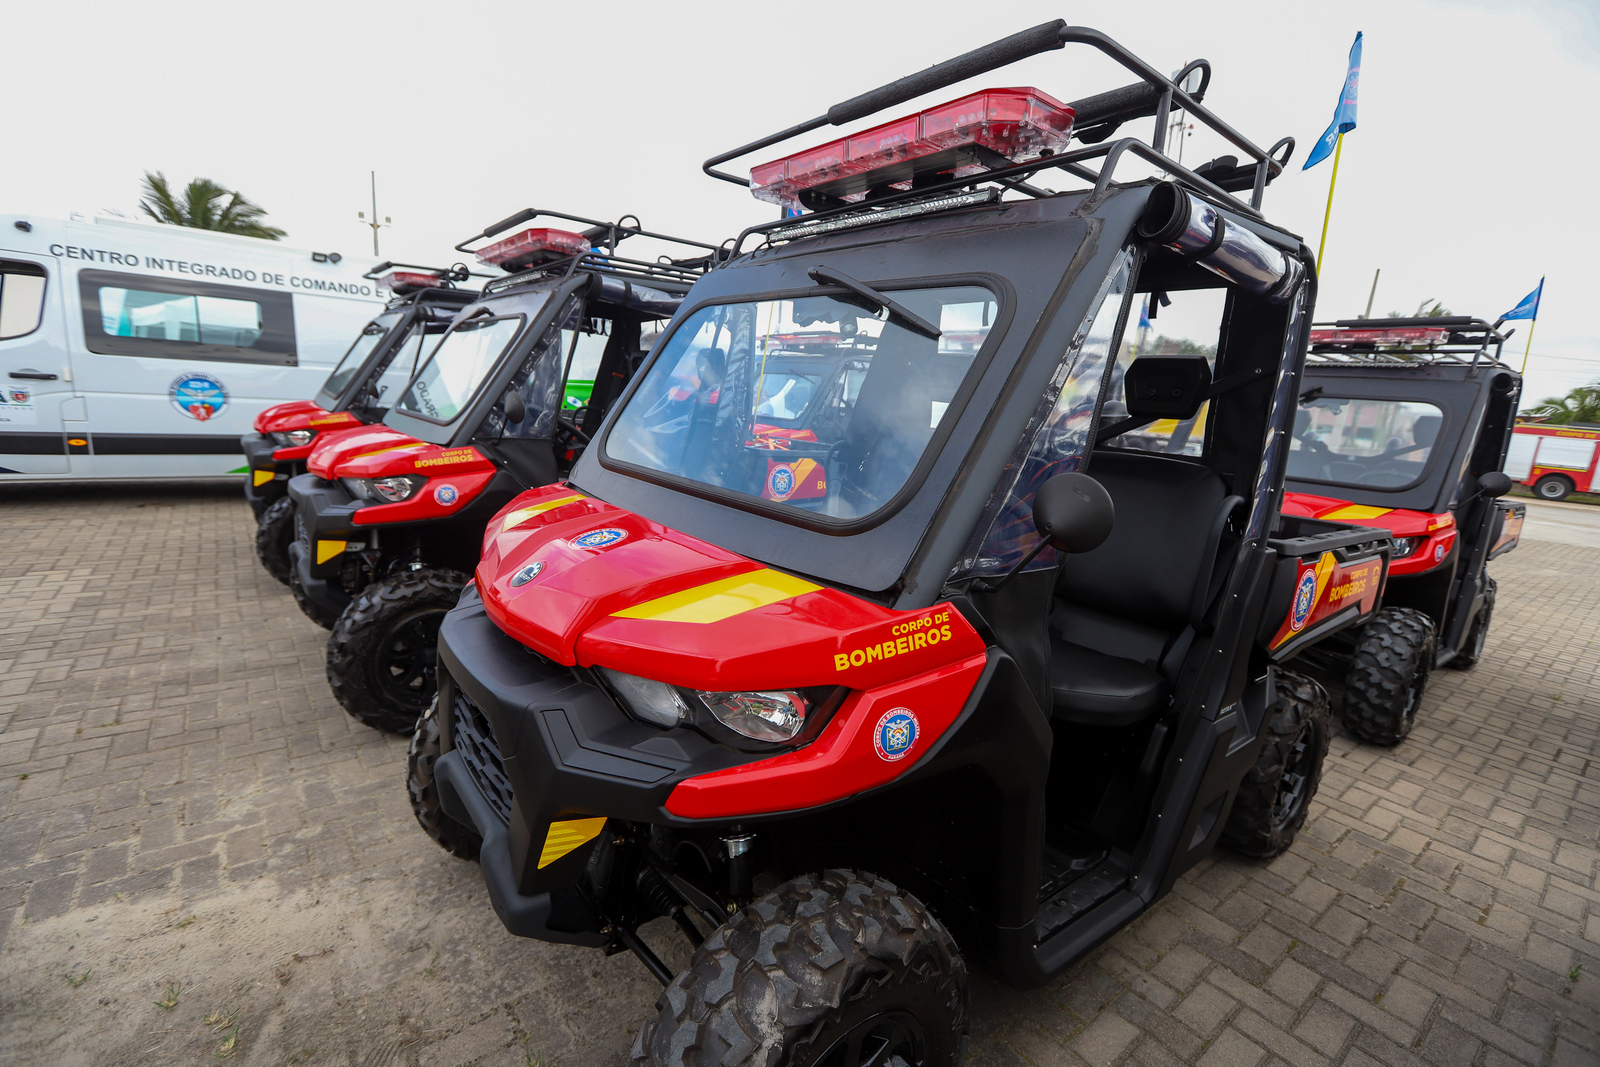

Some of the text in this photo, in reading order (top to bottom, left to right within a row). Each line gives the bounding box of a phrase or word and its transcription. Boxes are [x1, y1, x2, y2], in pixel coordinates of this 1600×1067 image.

[50, 243, 139, 267] CENTRO
[145, 256, 257, 281] INTEGRADO
[262, 272, 285, 286] DE
[290, 276, 370, 297] COMANDO
[414, 454, 473, 468] BOMBEIROS
[1350, 568, 1369, 580] CORPO DE
[1329, 579, 1367, 603] BOMBEIROS
[892, 612, 950, 635] CORPO DE
[834, 625, 951, 671] BOMBEIROS
[886, 709, 914, 719] BOMBEIROS
